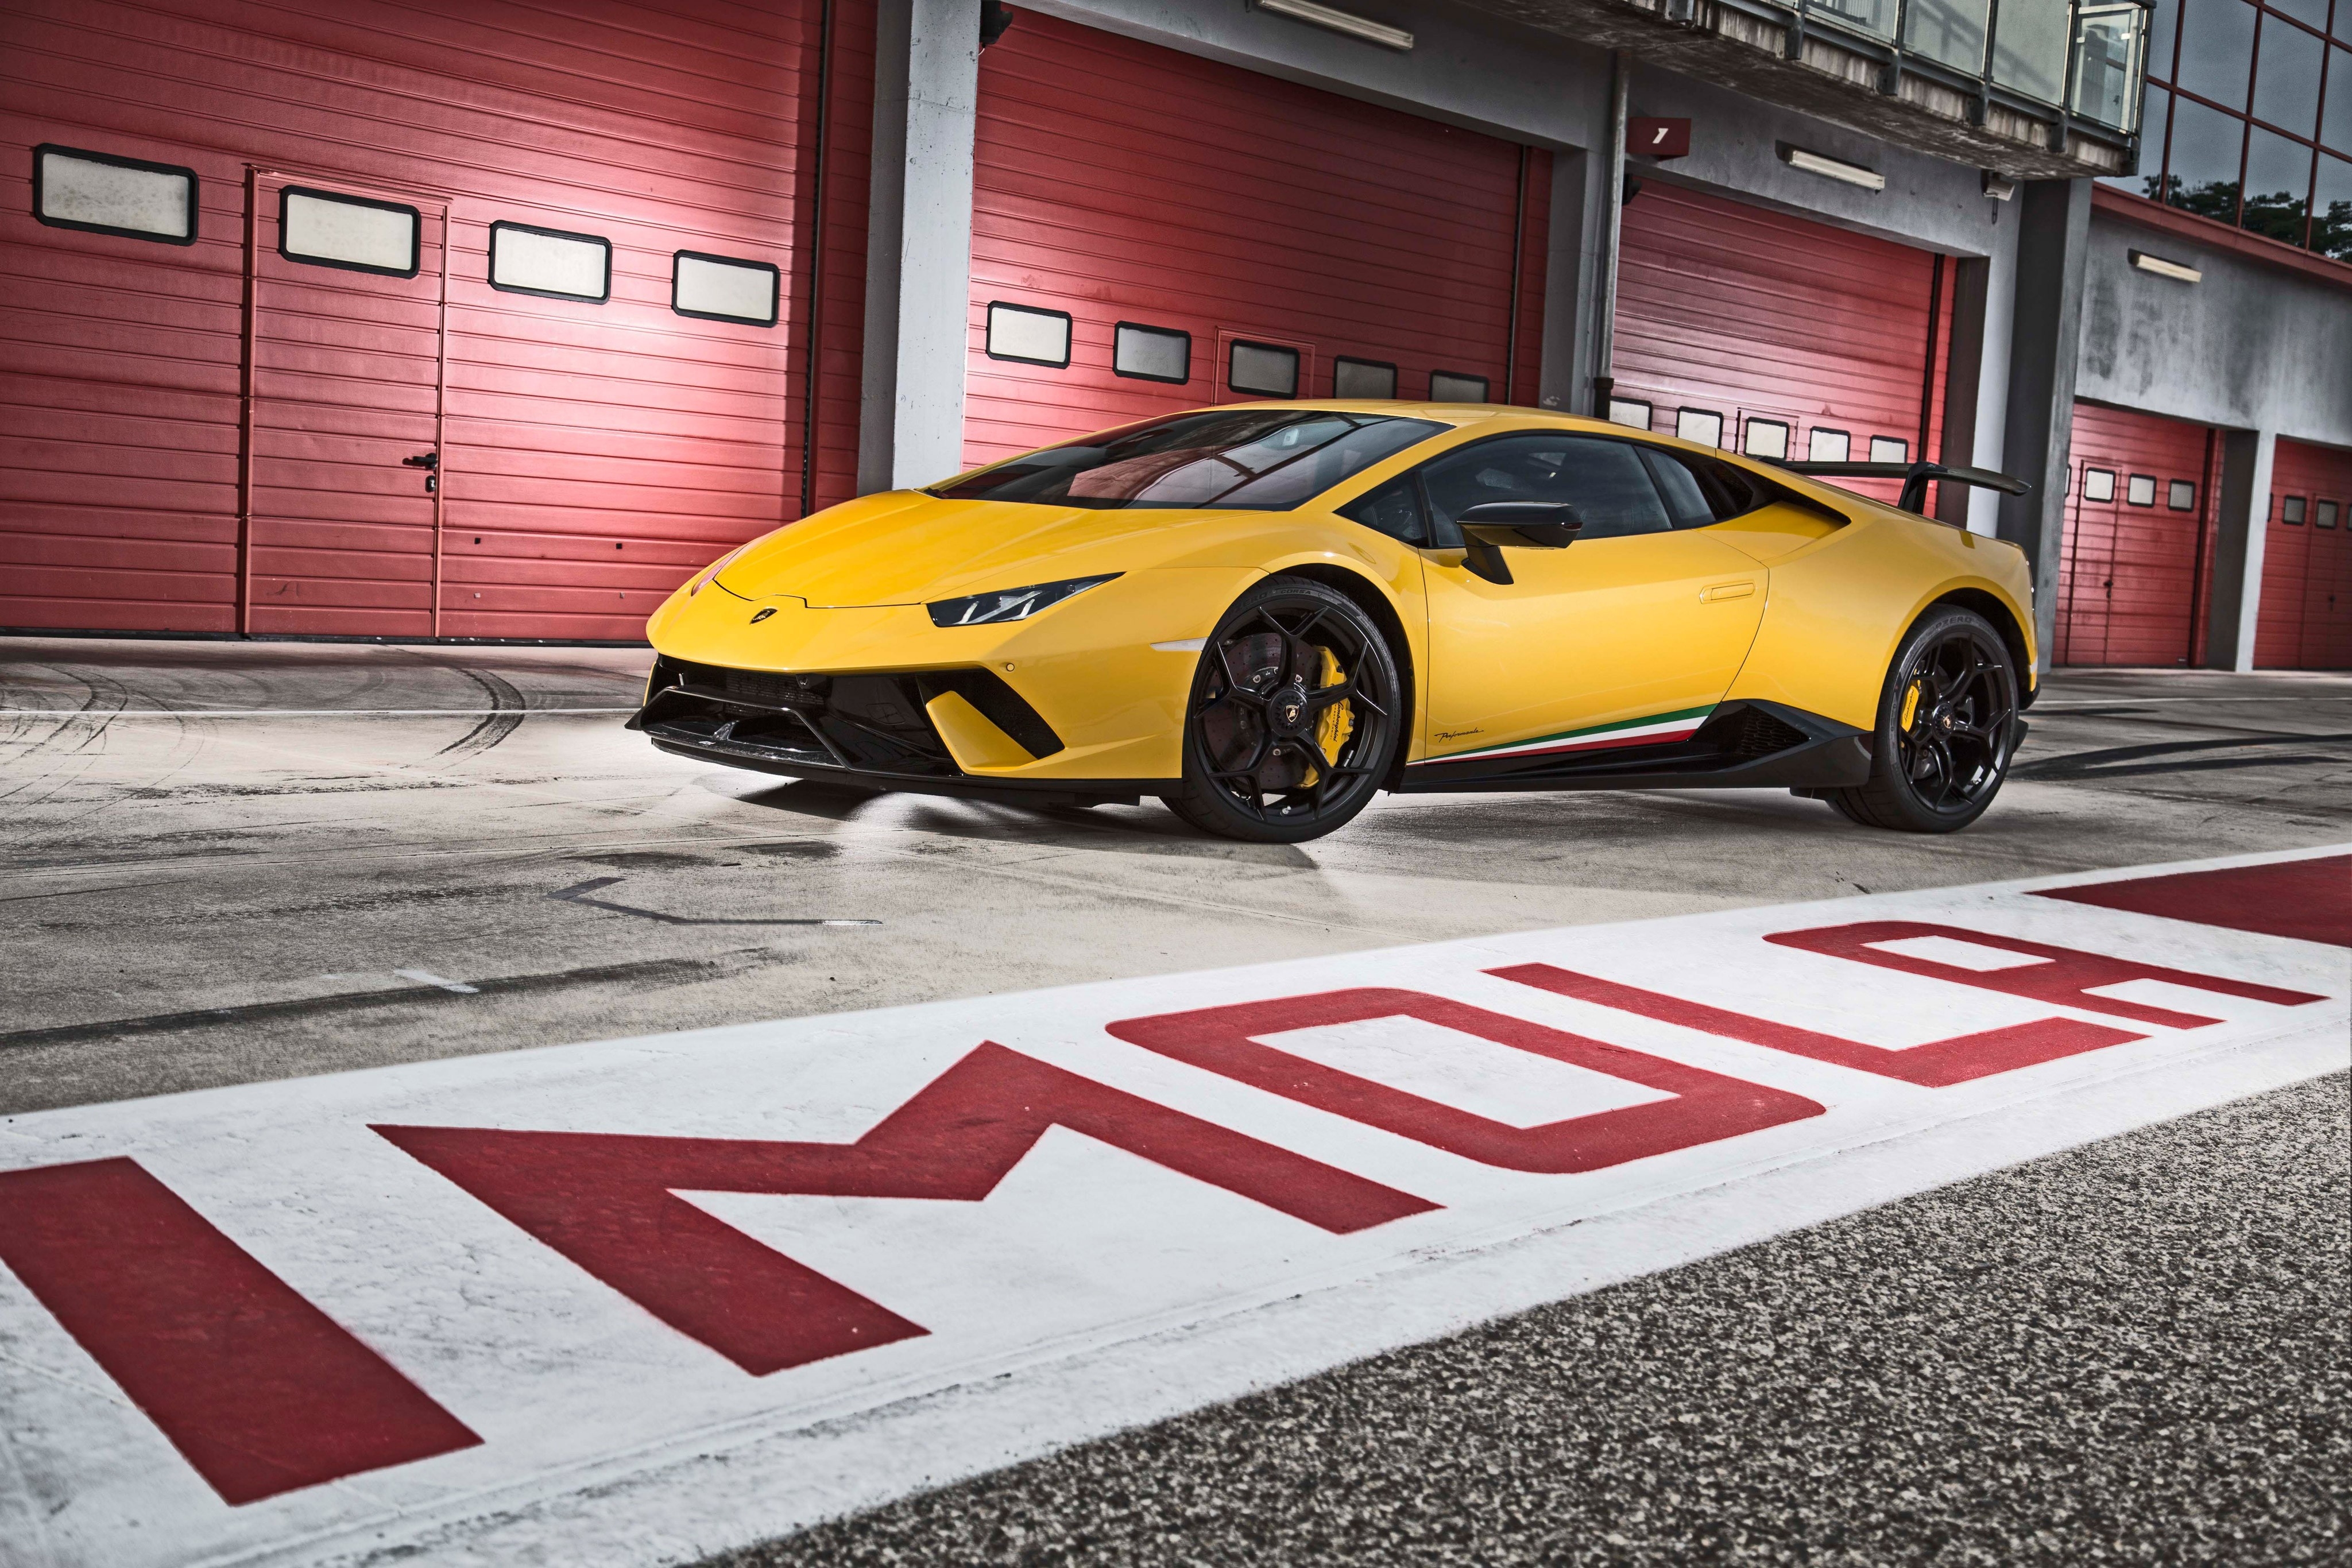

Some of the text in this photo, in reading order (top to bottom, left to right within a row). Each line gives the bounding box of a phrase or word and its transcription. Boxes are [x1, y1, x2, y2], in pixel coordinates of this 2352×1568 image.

[1652, 127, 1669, 144] 1
[1333, 701, 1344, 742] Lamborghini
[1434, 727, 1484, 743] Performante
[0, 920, 2330, 1507] IMOLA
